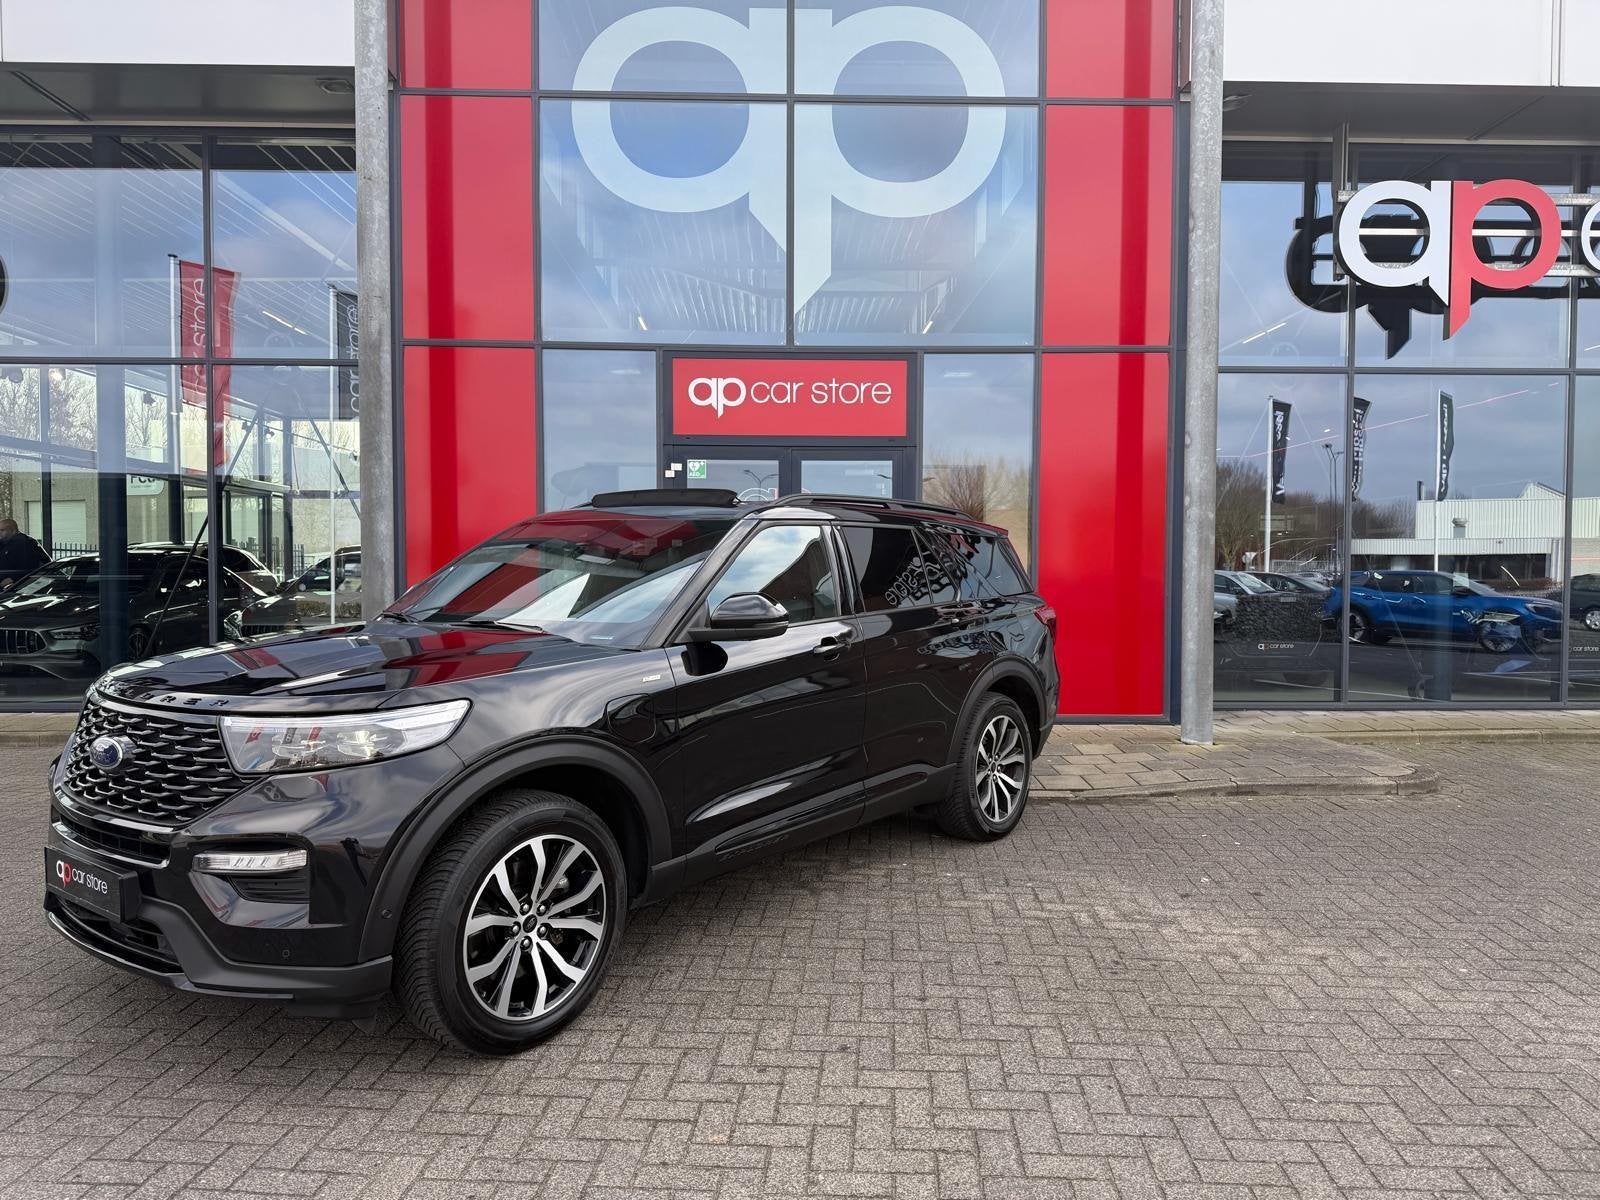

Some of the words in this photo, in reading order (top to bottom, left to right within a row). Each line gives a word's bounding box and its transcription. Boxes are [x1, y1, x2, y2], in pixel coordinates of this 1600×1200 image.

[1339, 178, 1562, 338] ap
[688, 377, 747, 419] ap
[750, 381, 804, 404] car
[811, 378, 892, 404] store
[56, 860, 72, 888] ap
[72, 868, 86, 884] car
[86, 873, 108, 894] store
